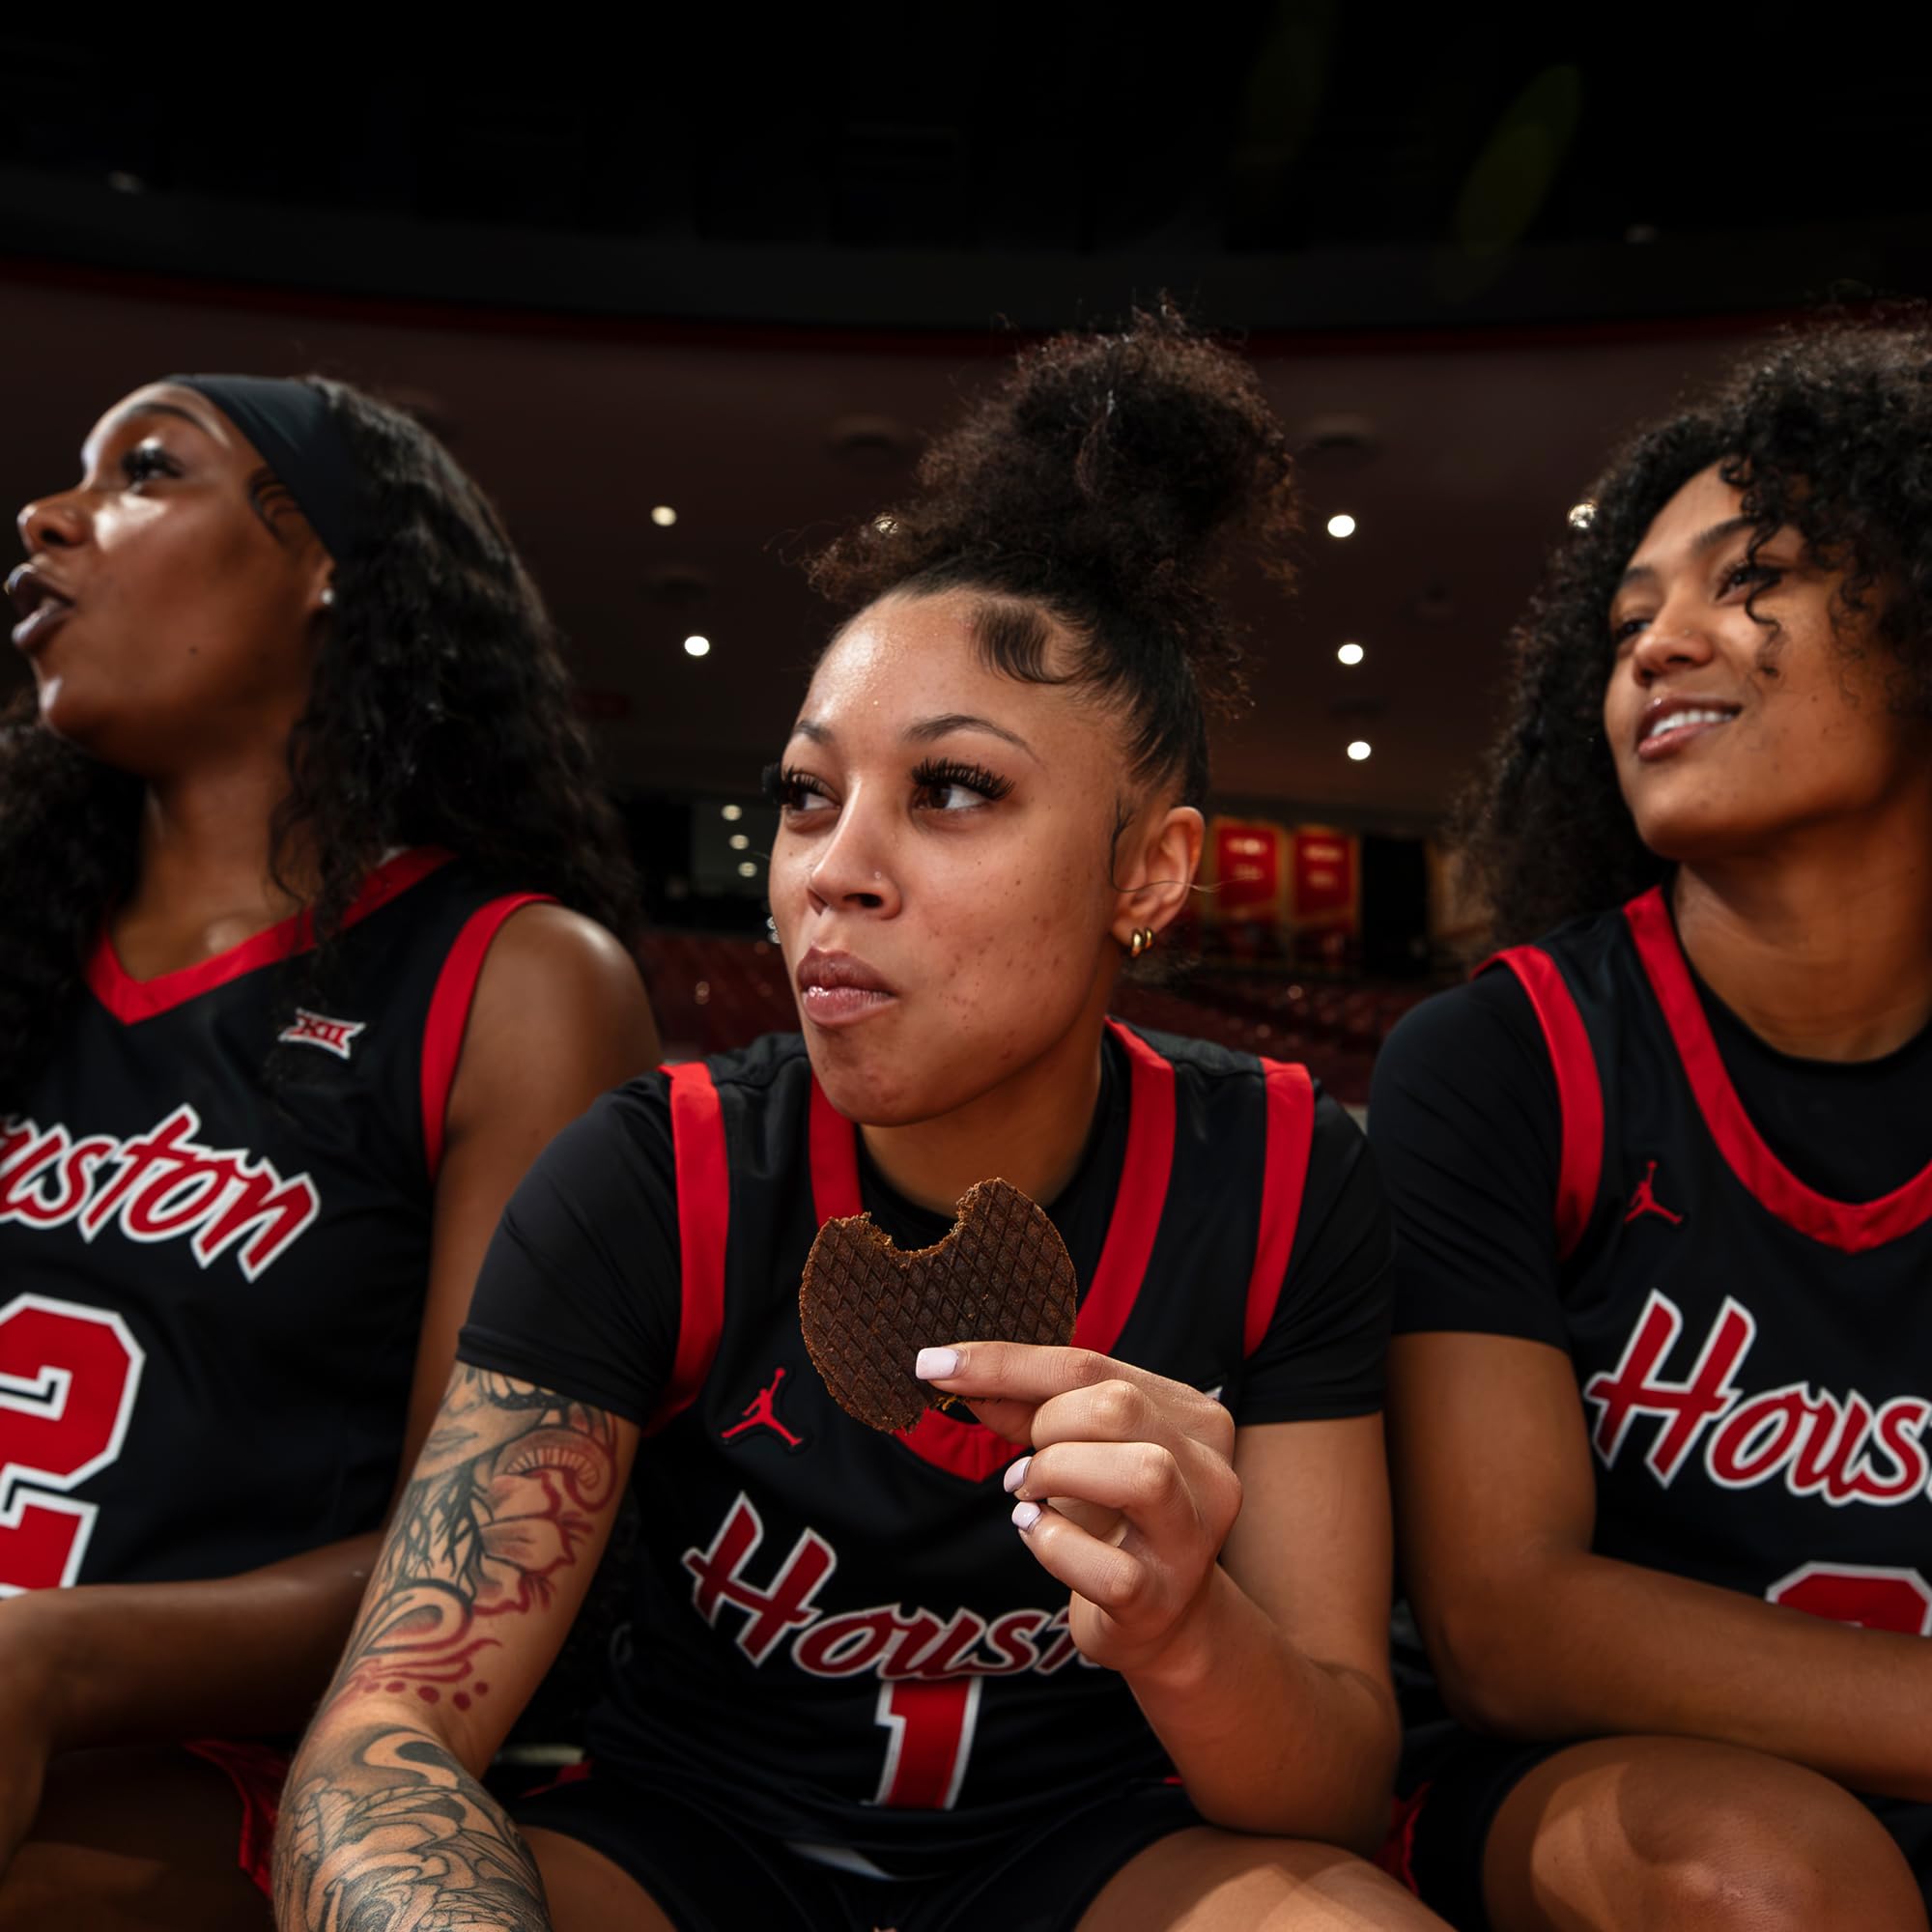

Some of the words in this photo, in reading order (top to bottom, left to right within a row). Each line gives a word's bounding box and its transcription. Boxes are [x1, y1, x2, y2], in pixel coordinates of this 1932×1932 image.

[0, 1102, 321, 1283] uston
[0, 1293, 146, 1600] 2
[1584, 1289, 1932, 1507] Hous
[860, 1673, 983, 1811] 1
